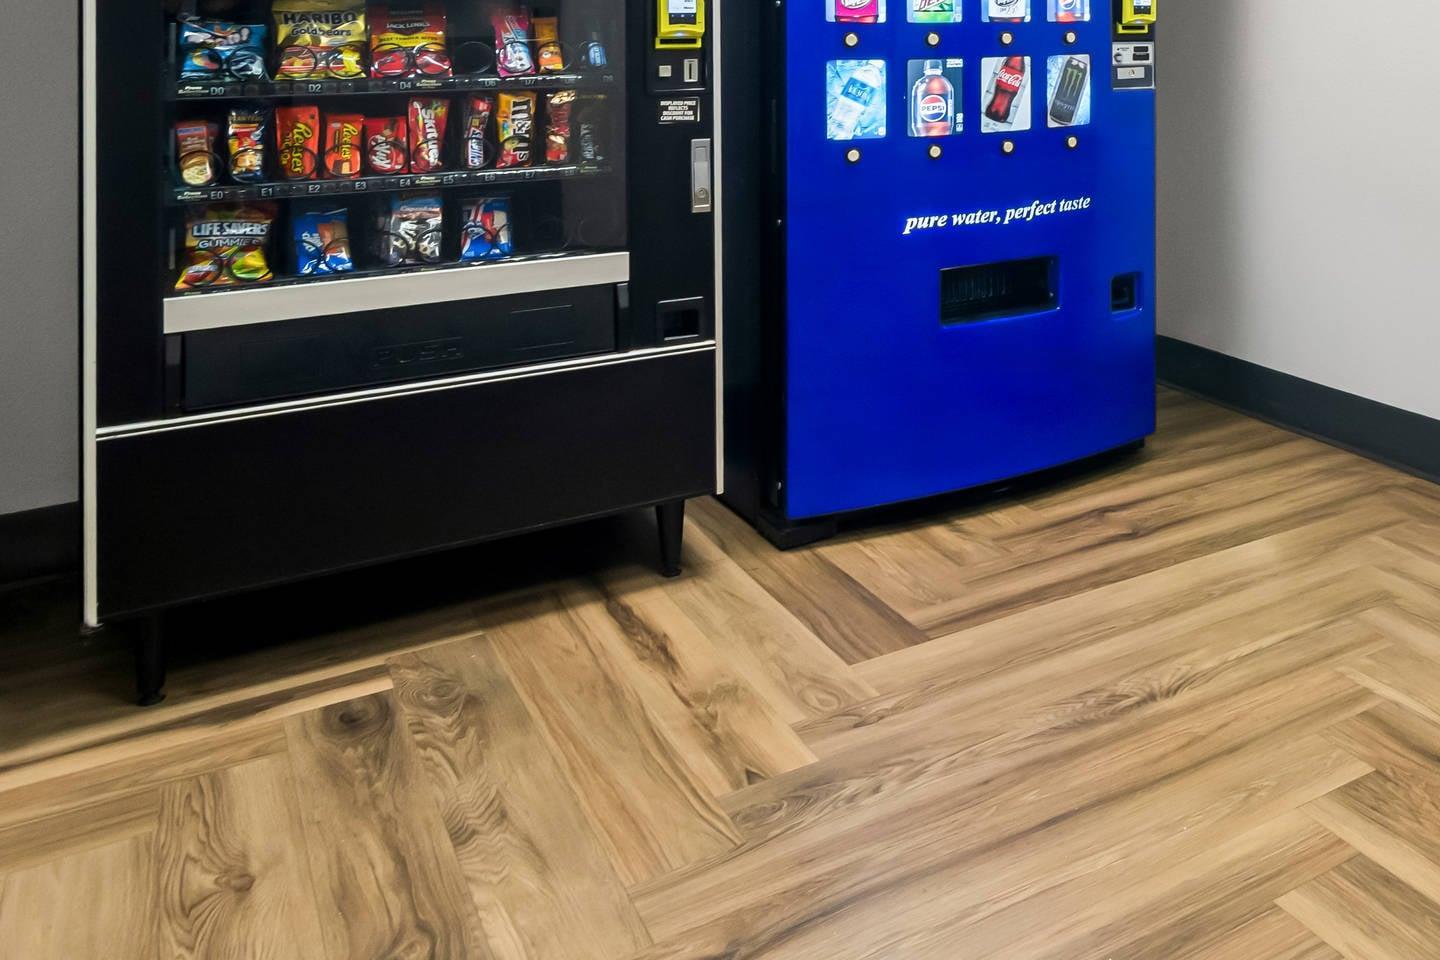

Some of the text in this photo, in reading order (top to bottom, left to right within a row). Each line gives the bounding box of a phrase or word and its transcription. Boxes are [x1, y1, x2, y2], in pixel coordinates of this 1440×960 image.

[283, 11, 356, 25] HARIBO
[291, 27, 352, 36] Goldbears
[308, 83, 321, 92] D2
[399, 81, 411, 90] D4
[211, 87, 224, 95] D0
[399, 178, 411, 187] E4
[443, 176, 454, 185] E5
[308, 184, 321, 193] E2
[355, 181, 367, 190] E3
[210, 191, 224, 200] E0
[261, 188, 273, 196] E1
[902, 196, 1091, 235] pure water, perfect taste
[192, 222, 269, 236] LIFE SAVERS
